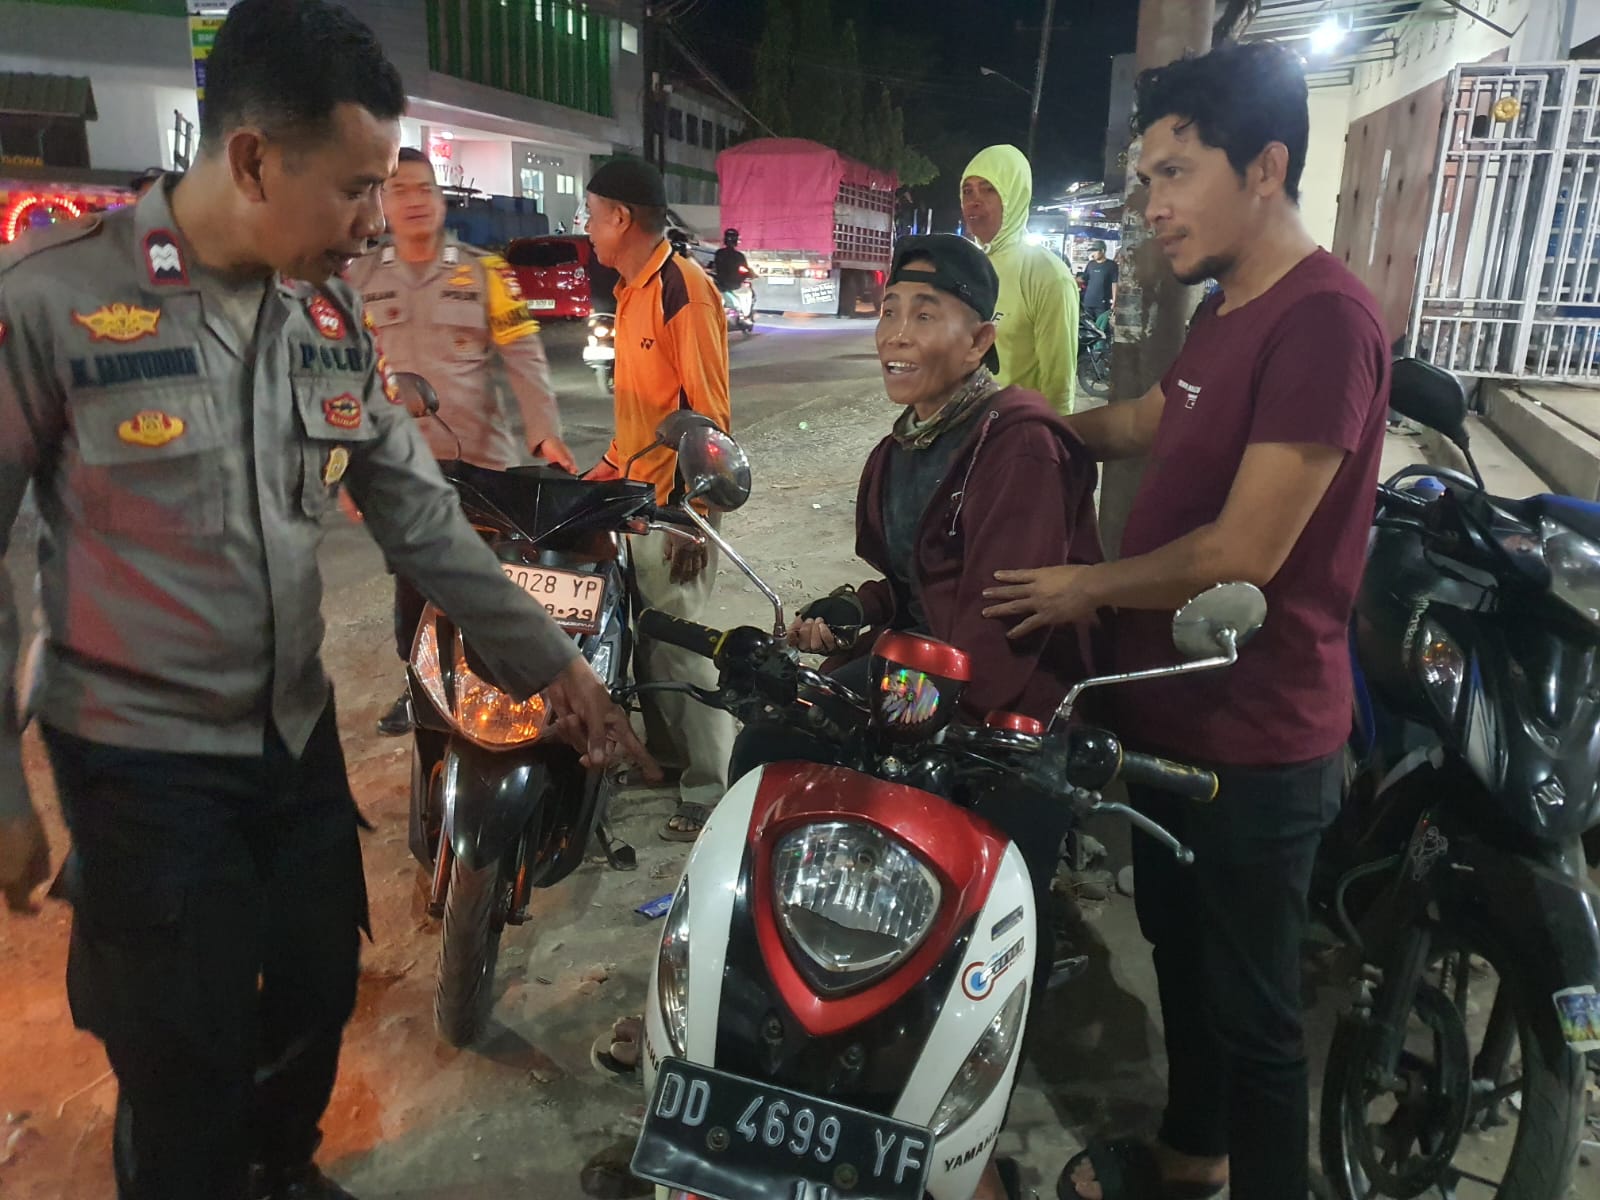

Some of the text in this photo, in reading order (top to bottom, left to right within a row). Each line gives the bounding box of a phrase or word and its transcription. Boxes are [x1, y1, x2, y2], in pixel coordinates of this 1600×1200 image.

[573, 578, 598, 600] YP
[655, 1072, 926, 1185] DD 4699 YF
